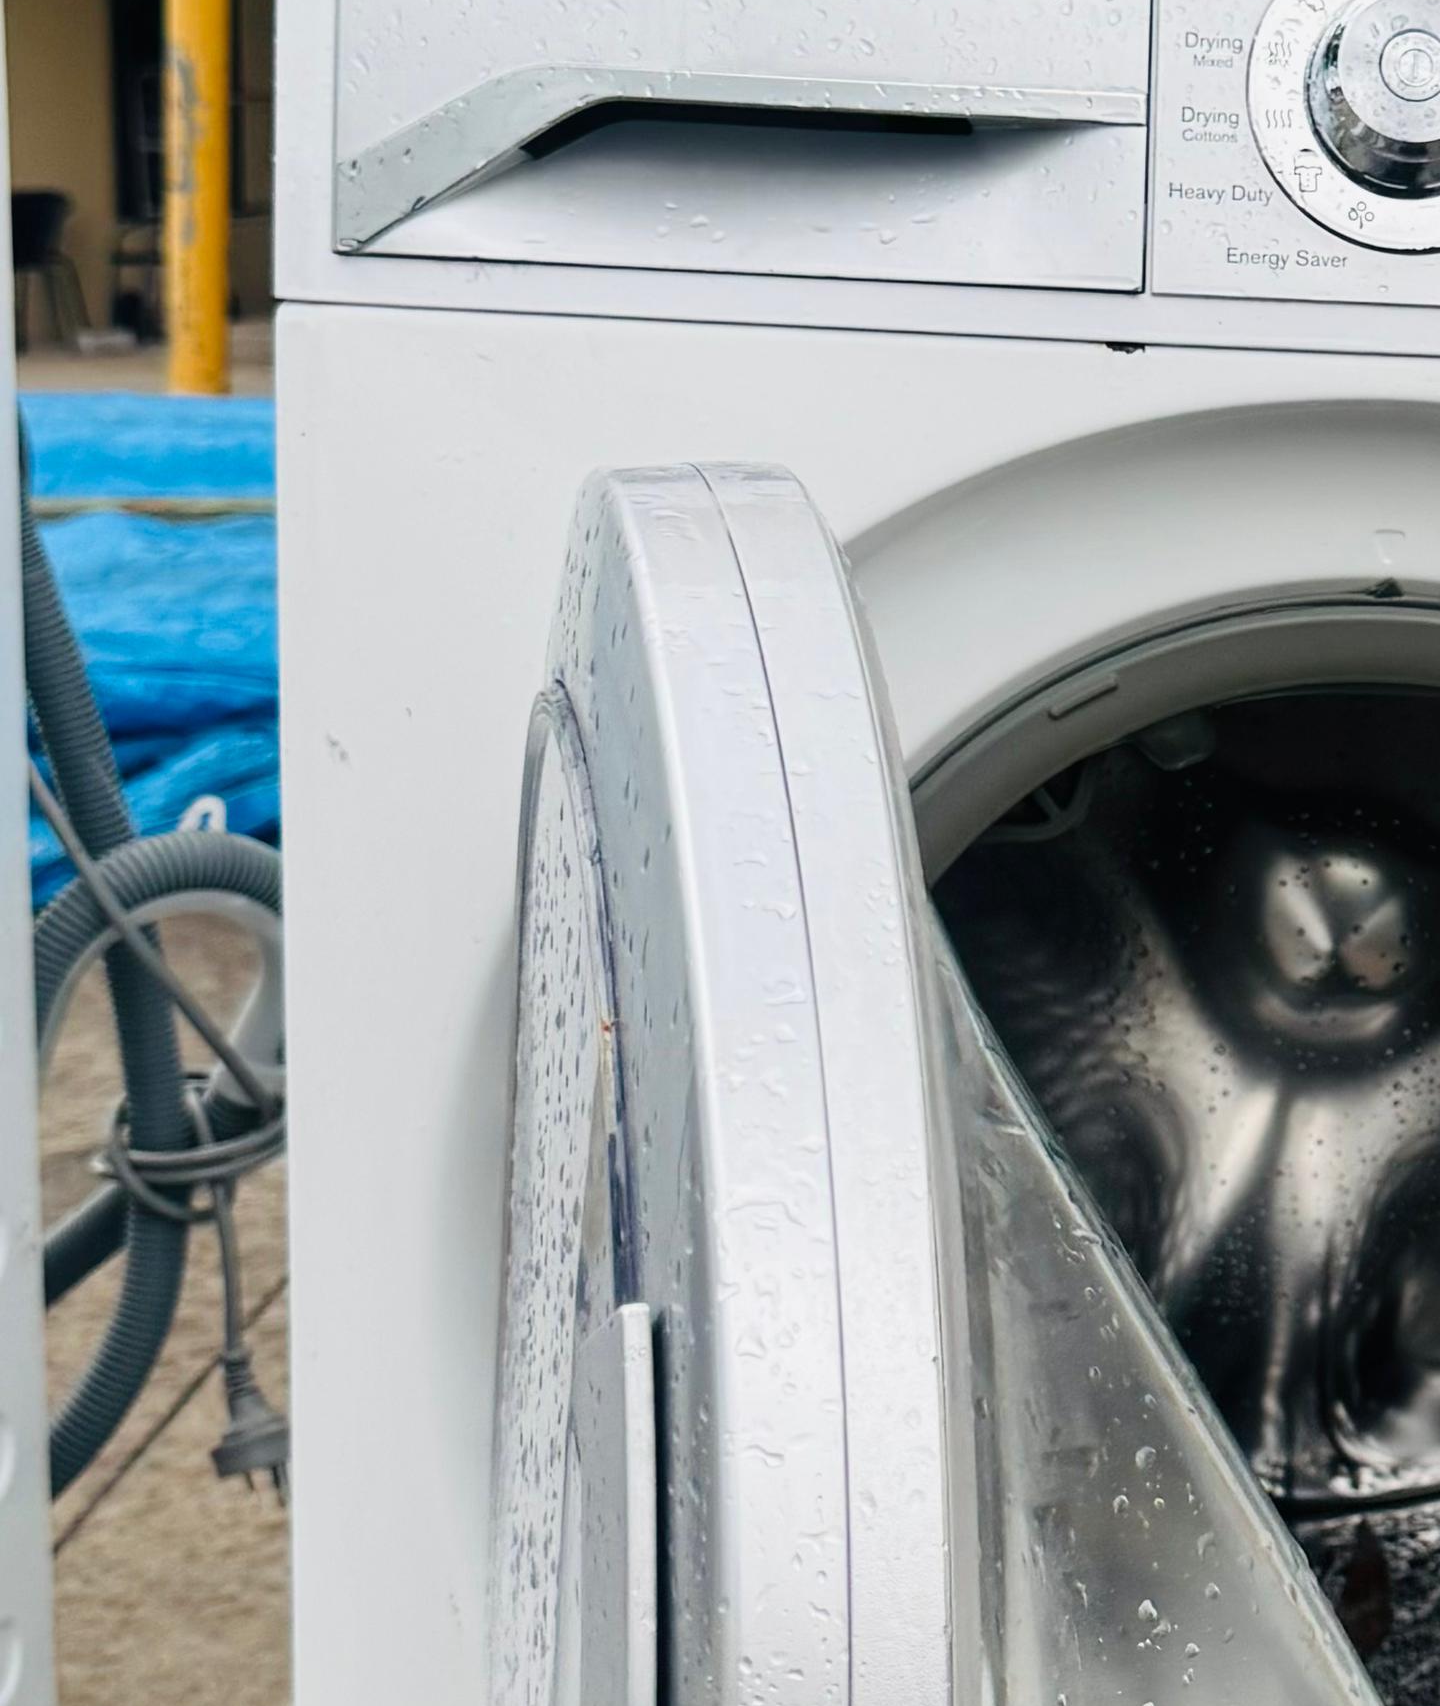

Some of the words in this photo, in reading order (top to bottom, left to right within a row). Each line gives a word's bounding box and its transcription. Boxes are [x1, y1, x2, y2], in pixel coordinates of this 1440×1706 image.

[1184, 31, 1244, 55] Drying
[1192, 53, 1234, 69] Mixed
[1181, 106, 1241, 131] Drying
[1182, 128, 1239, 145] Cottons
[1168, 182, 1226, 205] Heavy
[1231, 184, 1275, 207] Duty
[1226, 247, 1290, 272] Energy
[1295, 249, 1349, 271] Saver
